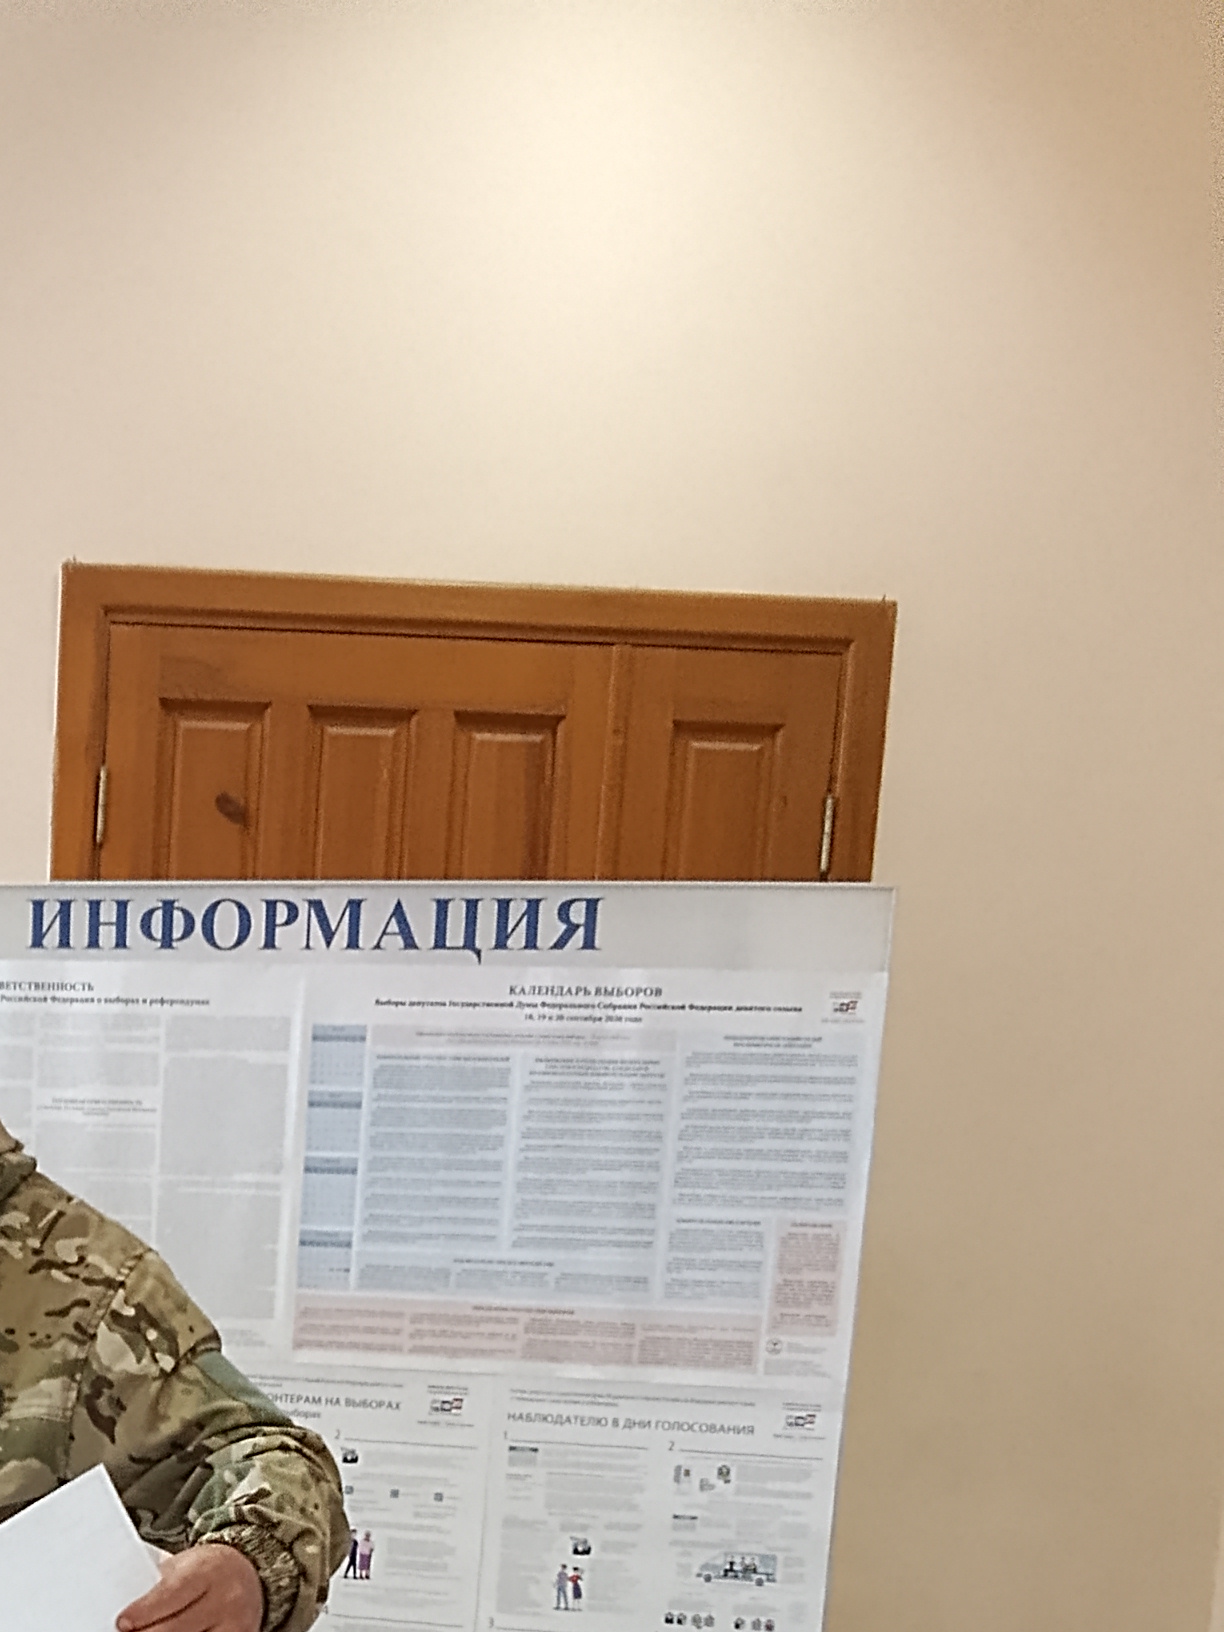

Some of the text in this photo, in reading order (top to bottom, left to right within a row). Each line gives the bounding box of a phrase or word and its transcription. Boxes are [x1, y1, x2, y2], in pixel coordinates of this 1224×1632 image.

[26, 897, 605, 965] ИНФОРМАЦИЯ
[508, 984, 664, 998] КАЛЕНДАРЬ ВЫБОРОВ
[266, 1392, 402, 1411] ОНТЕРАМ НА ВЫБОРАХ
[507, 1412, 755, 1435] НАБЛЮДАТЕЛЮ В ДНИ ГОЛОСОВАНИЯ
[667, 1440, 675, 1452] 2
